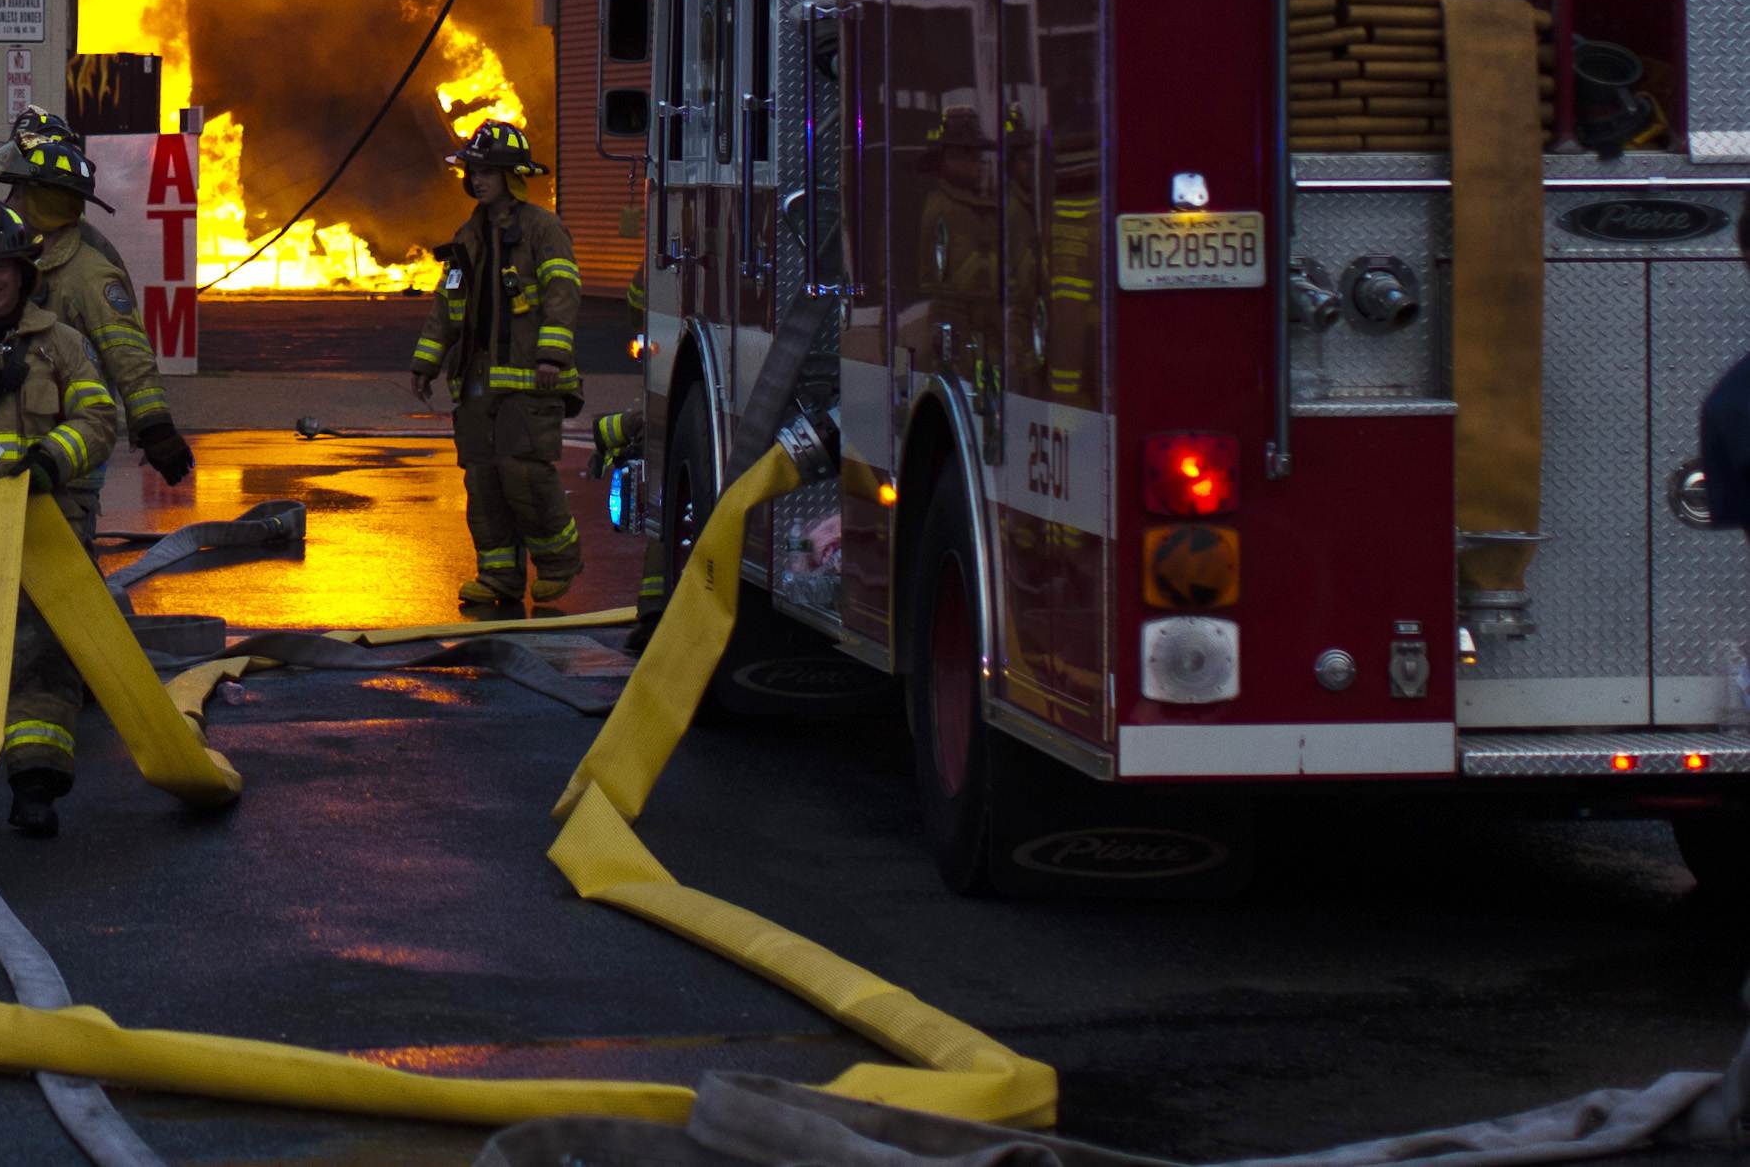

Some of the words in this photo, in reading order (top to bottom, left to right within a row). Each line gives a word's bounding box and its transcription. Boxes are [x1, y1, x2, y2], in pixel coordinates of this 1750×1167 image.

[1128, 232, 1256, 268] MG28558
[1028, 422, 1069, 501] 2501
[1051, 835, 1193, 865] Pierce
